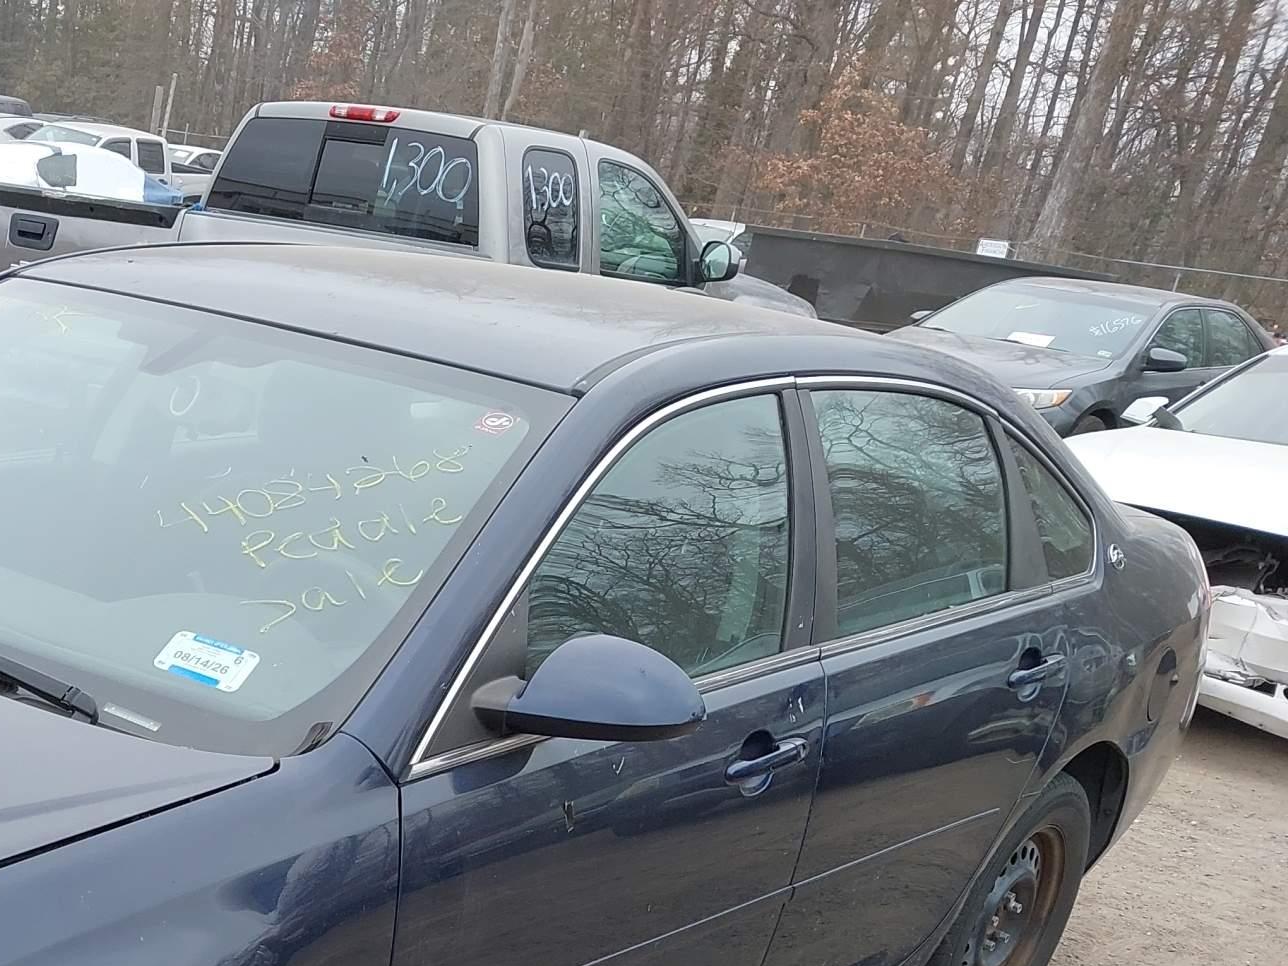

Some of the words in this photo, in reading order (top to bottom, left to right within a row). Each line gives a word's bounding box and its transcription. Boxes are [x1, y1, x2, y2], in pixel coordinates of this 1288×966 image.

[155, 445, 470, 533] 44084268
[173, 649, 231, 675] 08/14/26
[233, 655, 245, 665] 6
